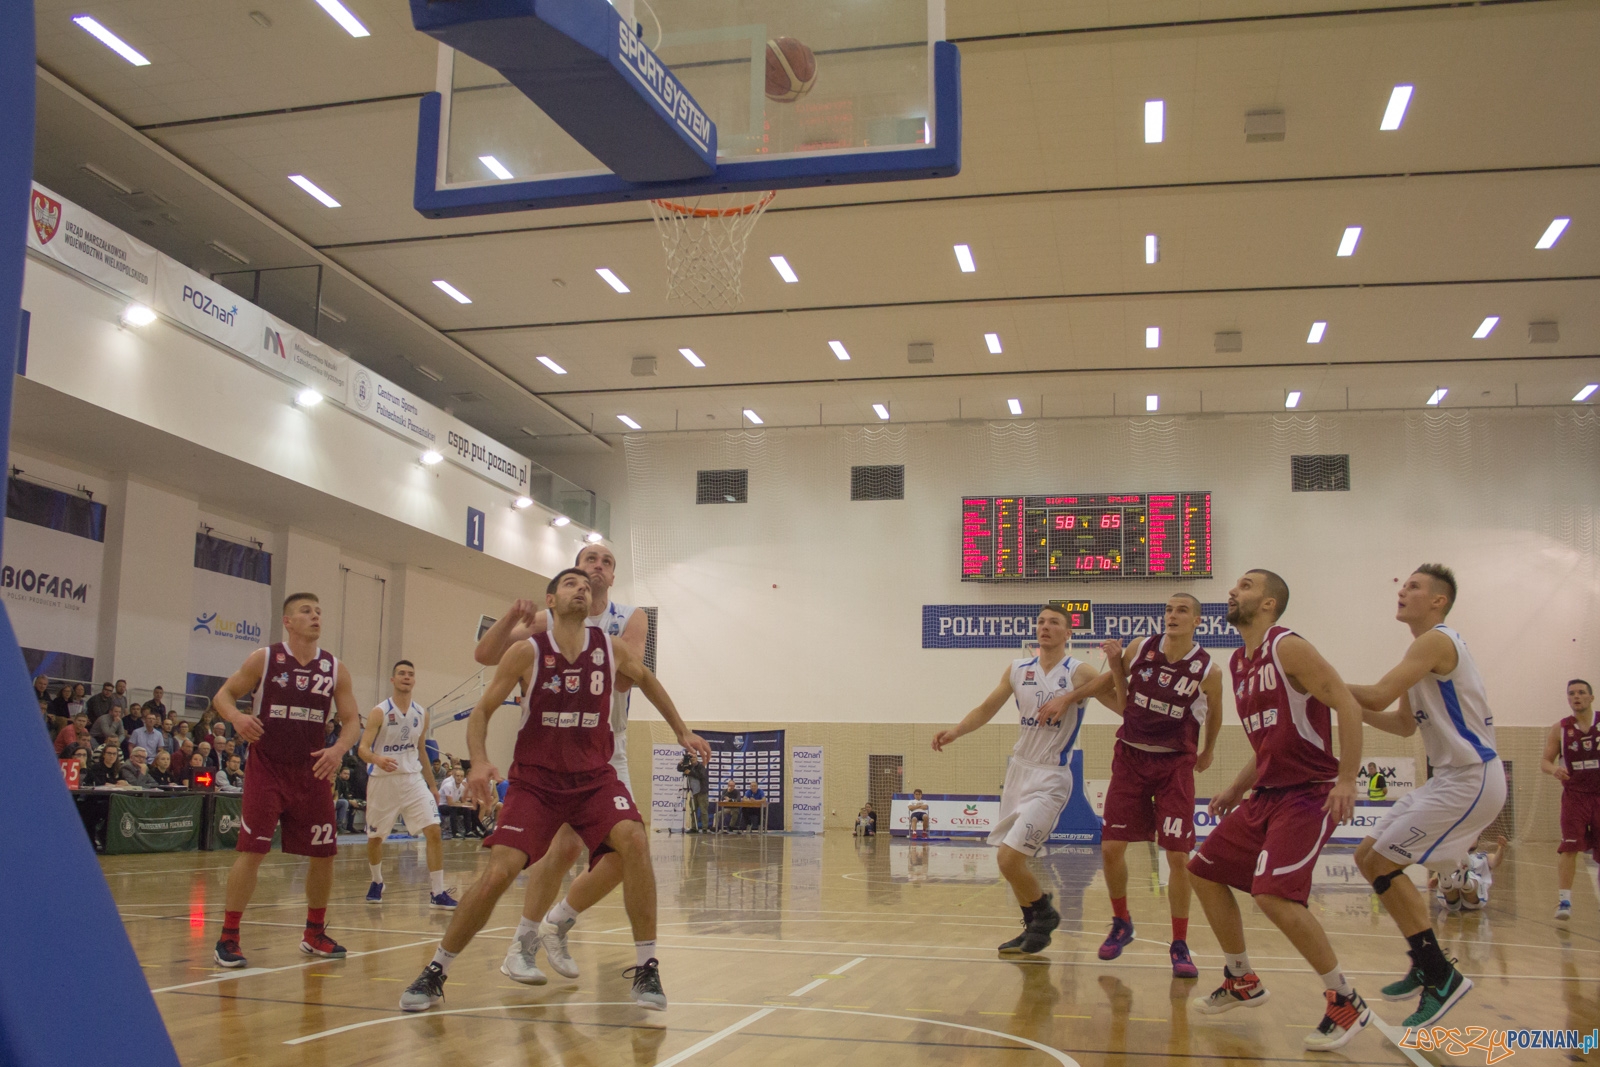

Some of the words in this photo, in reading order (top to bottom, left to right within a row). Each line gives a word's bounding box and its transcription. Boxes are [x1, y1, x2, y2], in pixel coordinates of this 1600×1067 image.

[619, 20, 665, 94] SPORT
[663, 75, 710, 144] SYSTEM
[66, 220, 84, 238] URZĄD
[85, 230, 127, 261] MARSZAŁKOWSKI
[378, 384, 401, 407] Centrum
[401, 397, 418, 416] Sportu
[448, 430, 527, 487] cspp.put.poznan.pl
[472, 514, 480, 547] 1
[1055, 515, 1075, 530] 58
[1101, 514, 1121, 529] 65
[0, 565, 87, 603] BIOFARM
[214, 630, 233, 638] biuro
[1104, 616, 1240, 636] POZNSKA
[311, 674, 333, 697] 22
[590, 671, 604, 695] 8
[1173, 676, 1200, 697] 44
[1257, 663, 1277, 692] 10
[613, 796, 630, 810] 8
[950, 817, 990, 826] CYMES
[1163, 816, 1183, 838] 44
[310, 823, 333, 845] 22
[1400, 826, 1427, 848] 7
